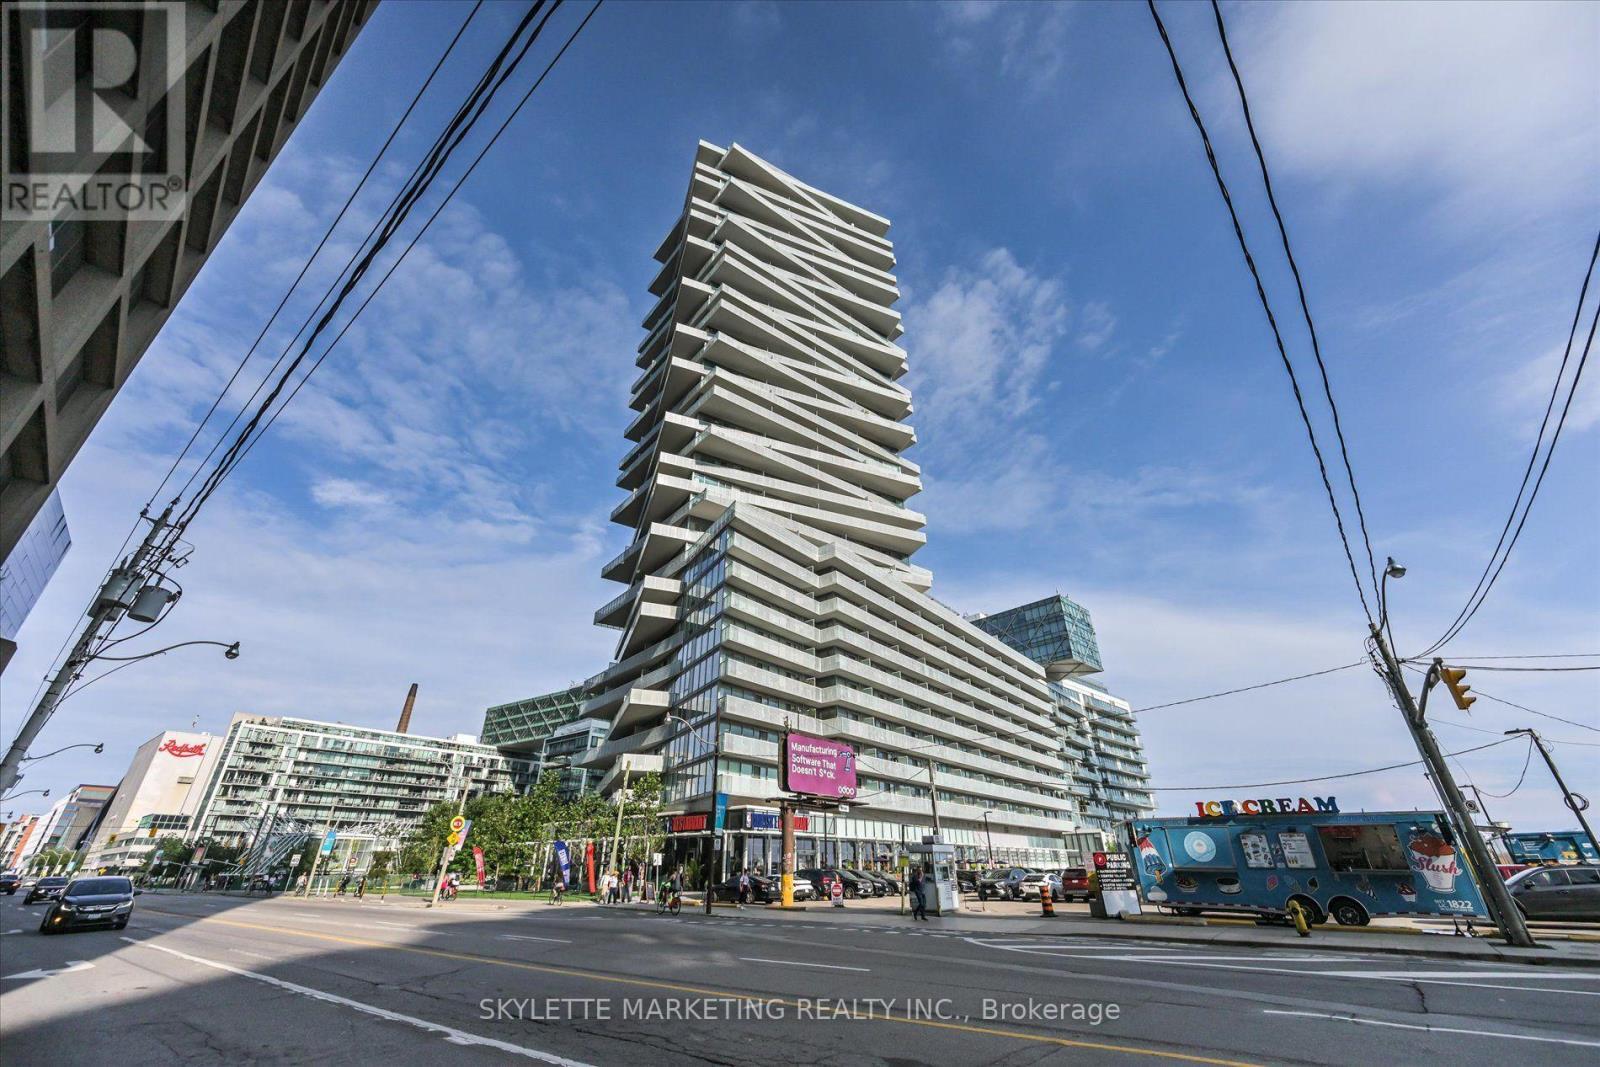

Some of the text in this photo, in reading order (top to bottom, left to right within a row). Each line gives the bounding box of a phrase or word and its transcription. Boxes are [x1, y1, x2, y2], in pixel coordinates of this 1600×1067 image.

[791, 742, 838, 758] Manufacturing
[791, 753, 836, 770] Software That
[1196, 796, 1340, 817] ICE CREAM
[1411, 856, 1460, 875] Slush
[1447, 900, 1474, 909] 1822
